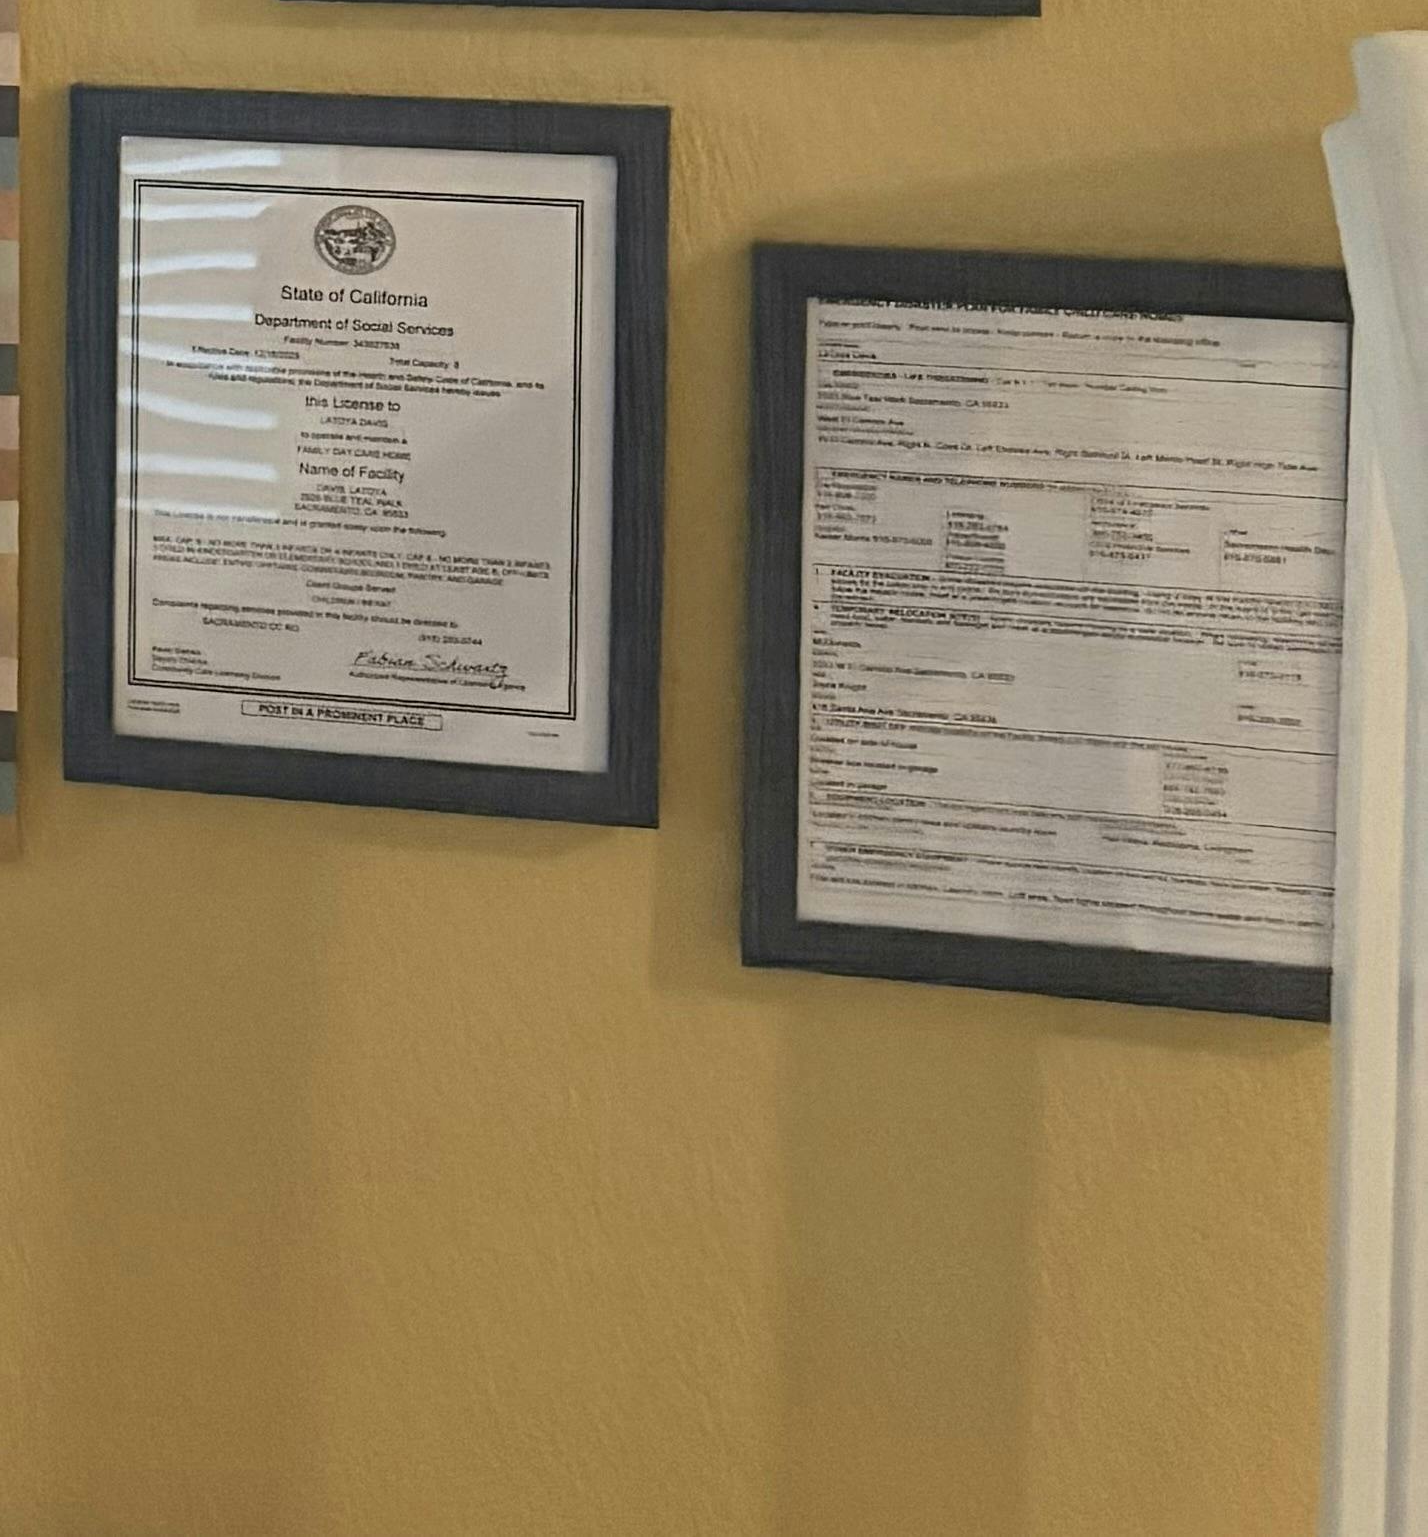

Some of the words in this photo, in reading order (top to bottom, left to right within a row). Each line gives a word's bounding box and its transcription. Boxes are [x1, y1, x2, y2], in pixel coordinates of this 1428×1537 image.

[281, 286, 322, 301] State
[329, 289, 345, 302] of
[350, 290, 428, 307] California
[255, 314, 331, 329] Department
[336, 318, 349, 329] of
[398, 322, 453, 337] Services
[299, 463, 338, 476] Name
[342, 466, 355, 477] of
[359, 467, 404, 483] Facility
